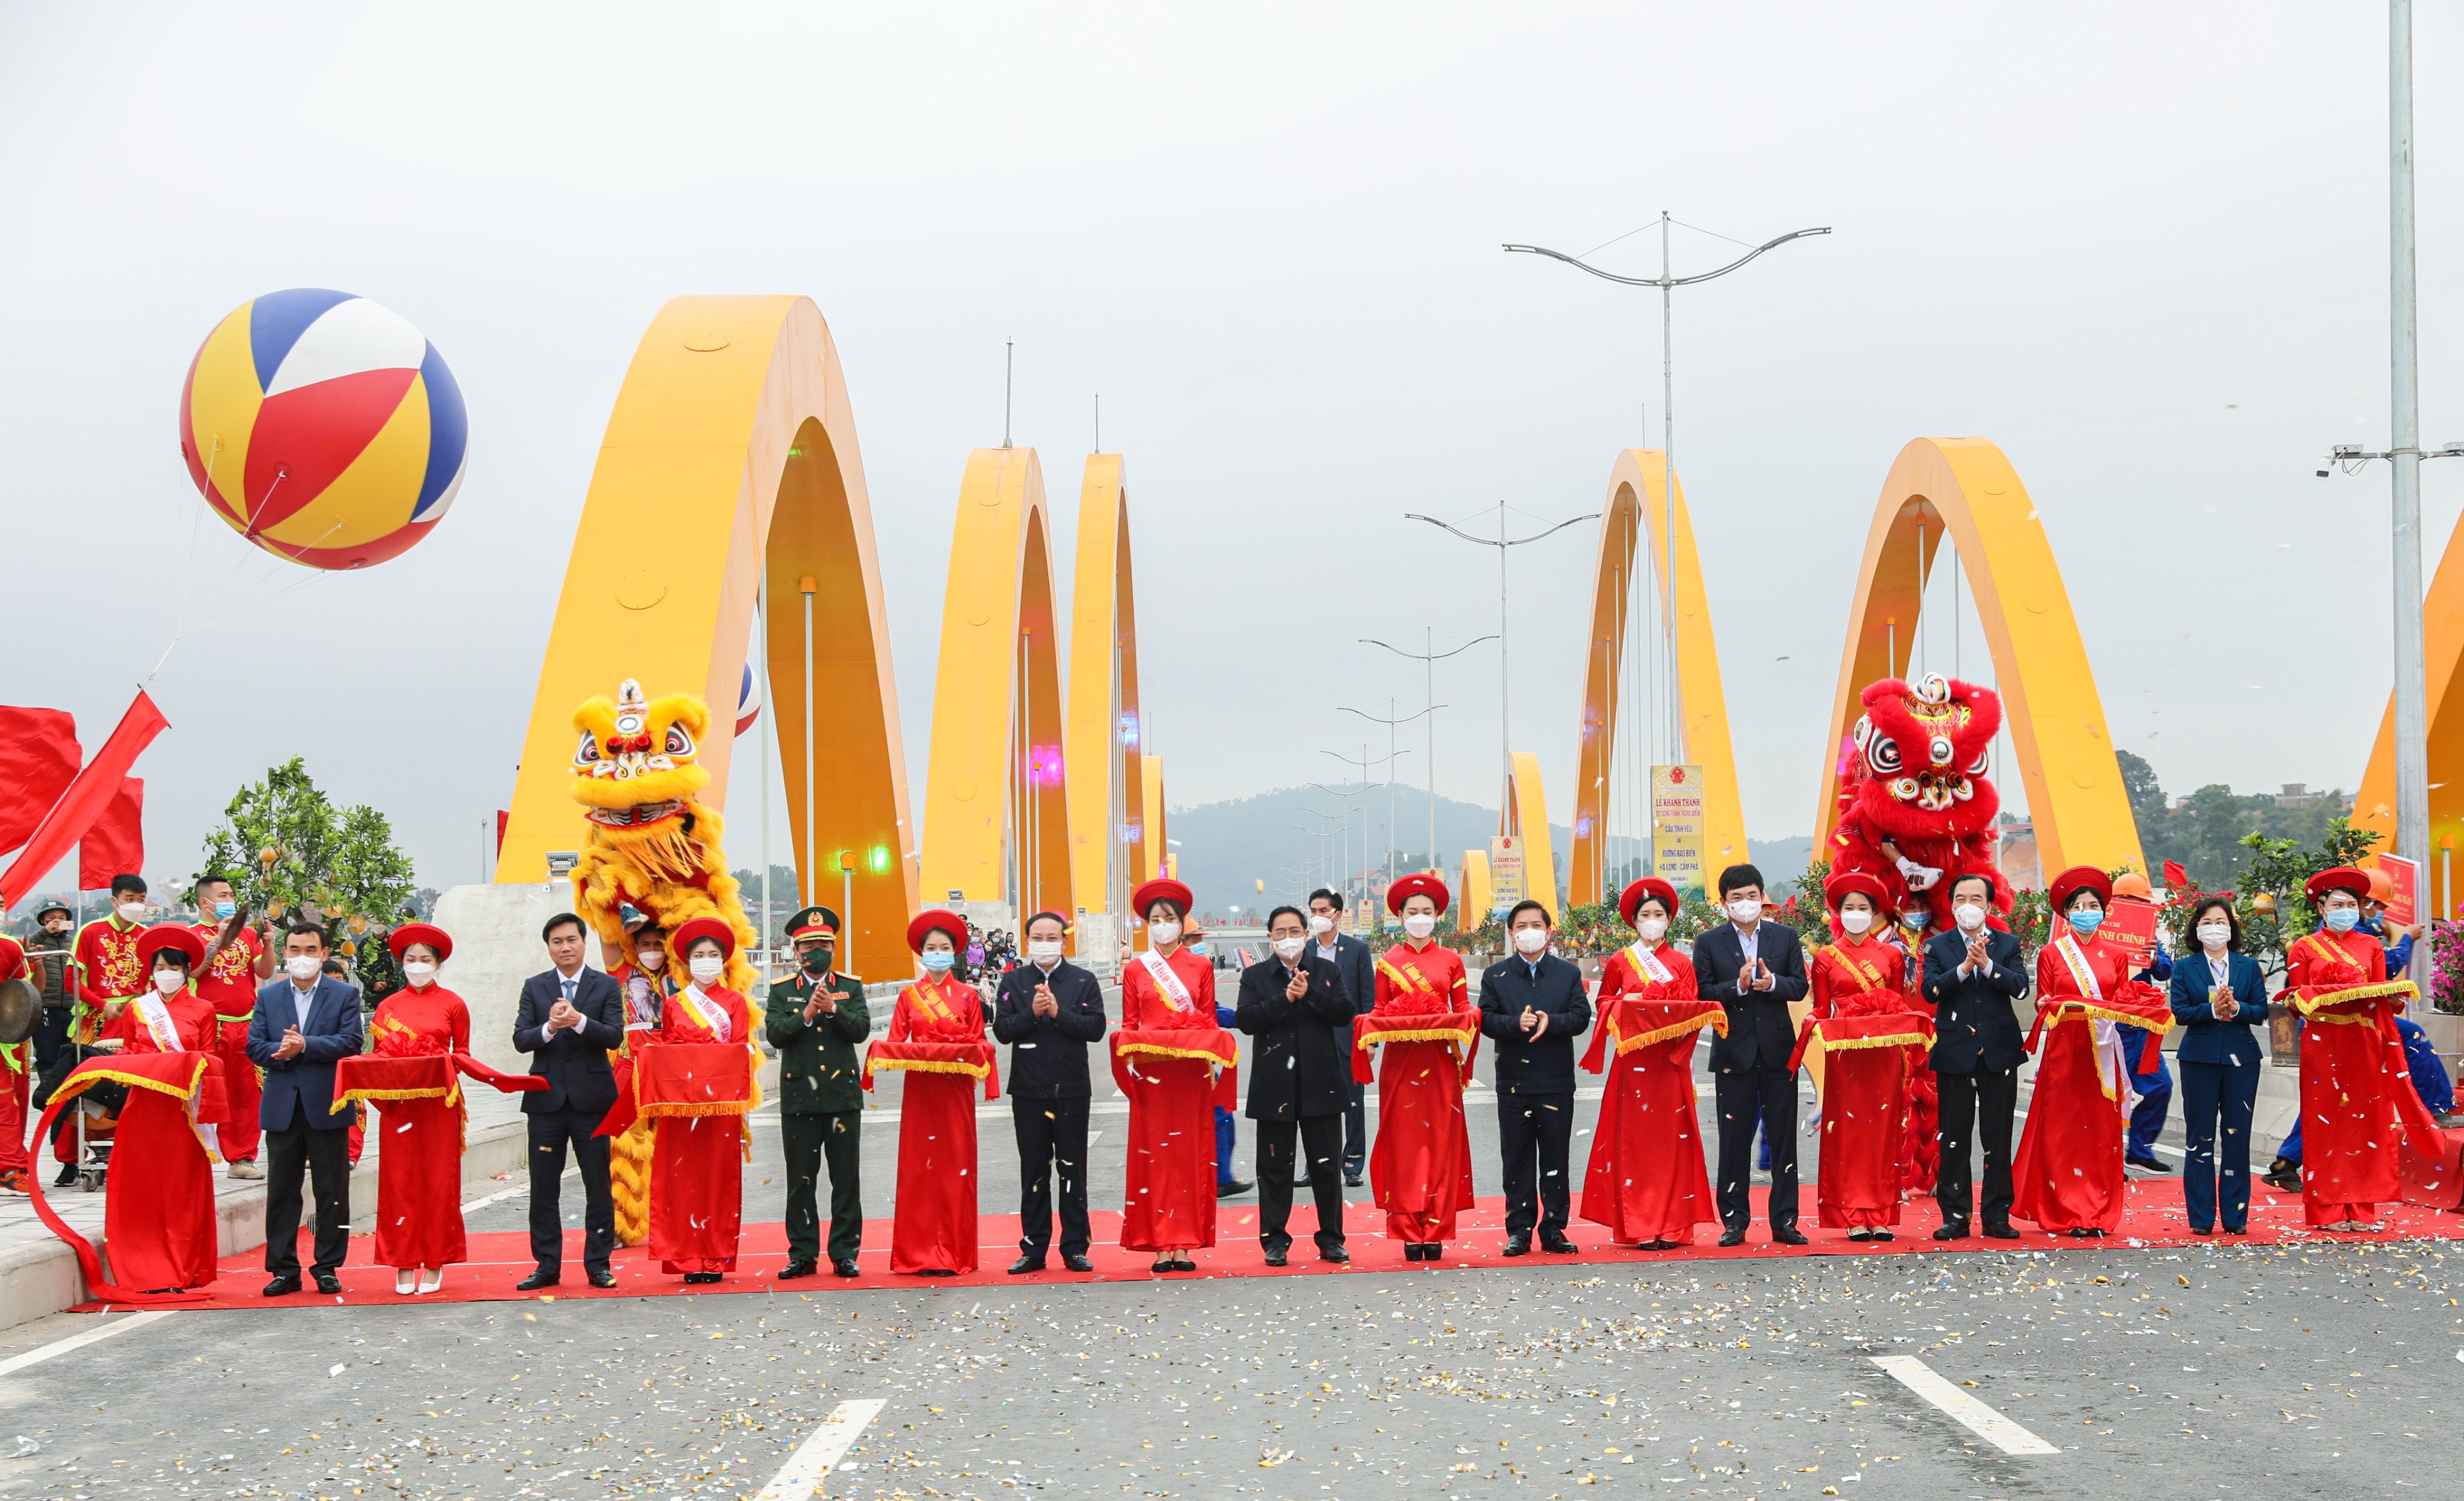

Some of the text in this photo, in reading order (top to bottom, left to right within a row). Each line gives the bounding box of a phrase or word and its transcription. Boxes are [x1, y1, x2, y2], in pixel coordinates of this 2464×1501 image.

[1656, 794, 1700, 807] LỄ KHÁNH THÀNH
[1684, 824, 1692, 833] YÊU
[1686, 847, 1695, 857] BIỂN
[1660, 863, 1665, 872] HẠ
[2116, 932, 2146, 945] CHÍNH
[1863, 963, 1882, 982] KHÁNH
[1155, 966, 1171, 983] KHÁNH
[1165, 981, 1181, 997] THÀNH
